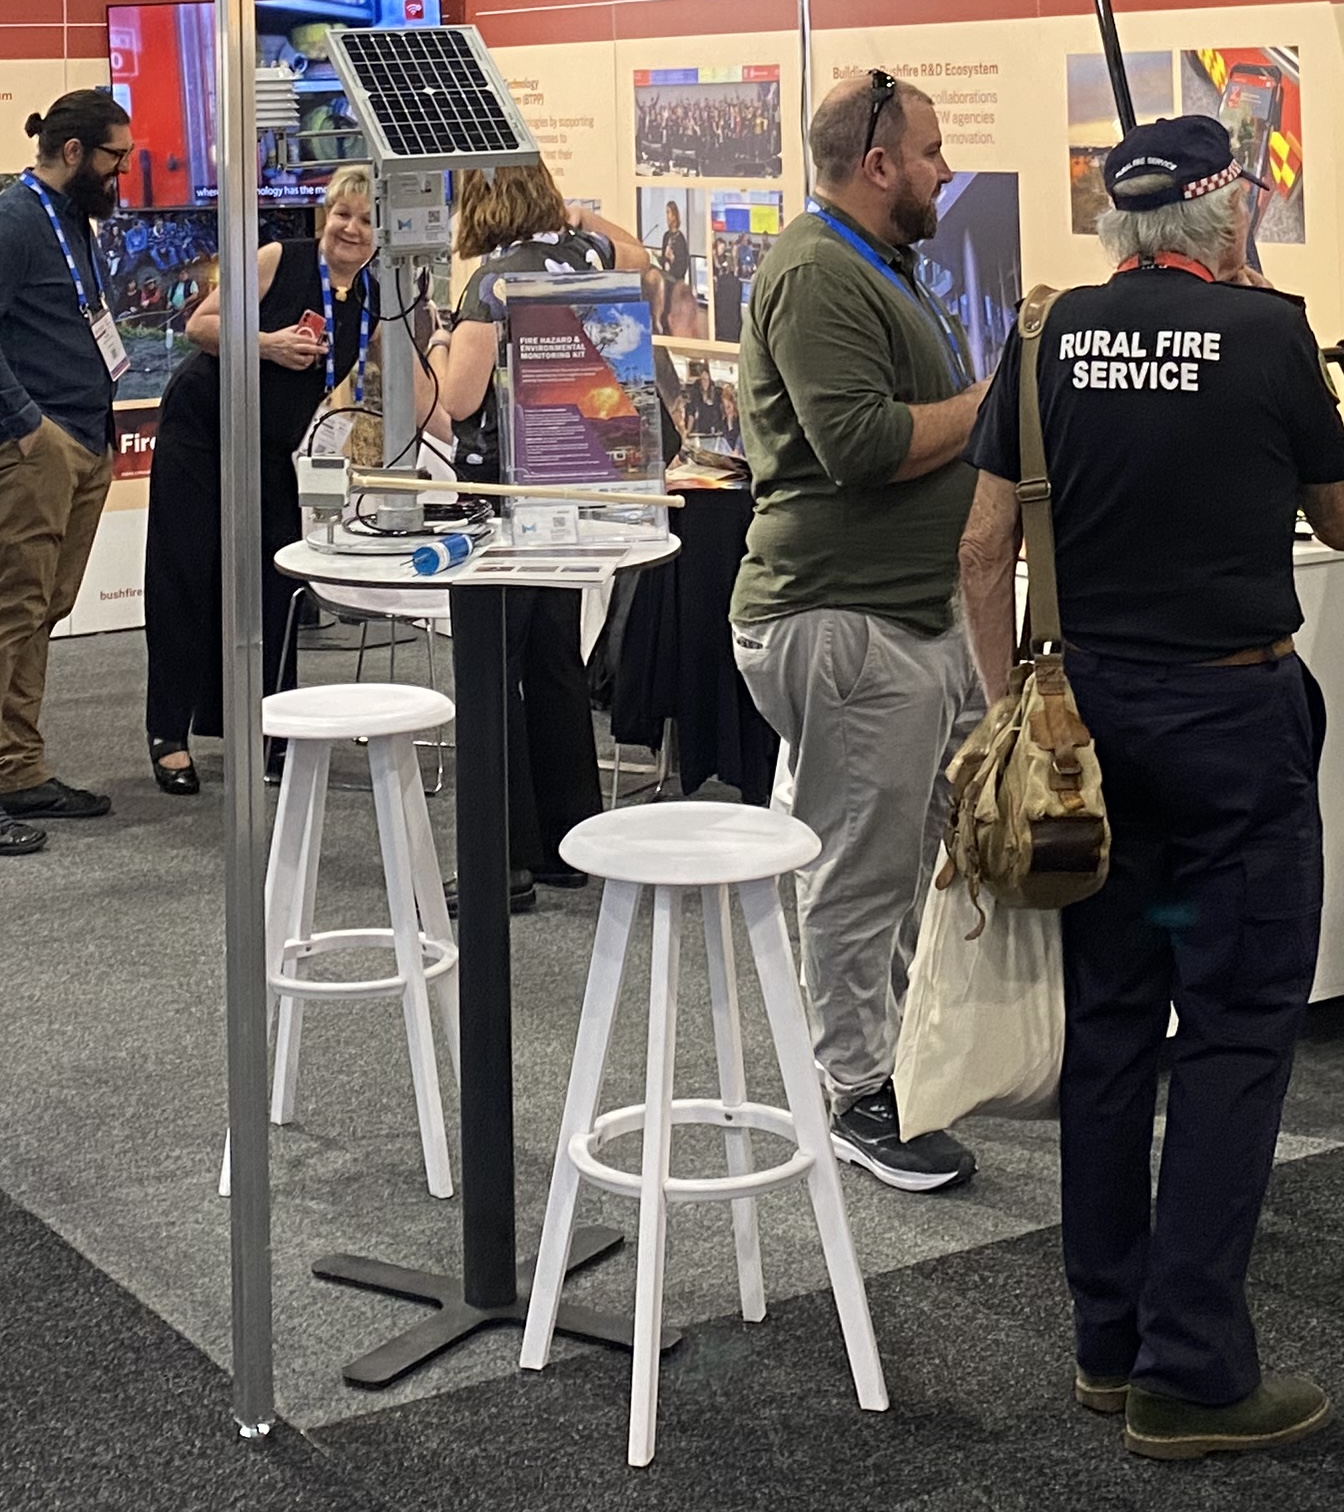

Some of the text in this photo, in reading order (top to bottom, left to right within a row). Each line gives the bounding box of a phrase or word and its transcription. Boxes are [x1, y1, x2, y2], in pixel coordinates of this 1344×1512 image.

[921, 64, 942, 76] R&D
[945, 62, 998, 77] Ecosystem
[953, 112, 994, 126] agencies
[1147, 156, 1177, 171] SERVICE
[284, 187, 298, 195] has
[300, 186, 314, 194] the
[1059, 330, 1222, 361] RURAL FIRE
[1072, 360, 1200, 392] SERVICE
[100, 588, 143, 601] bushfire
